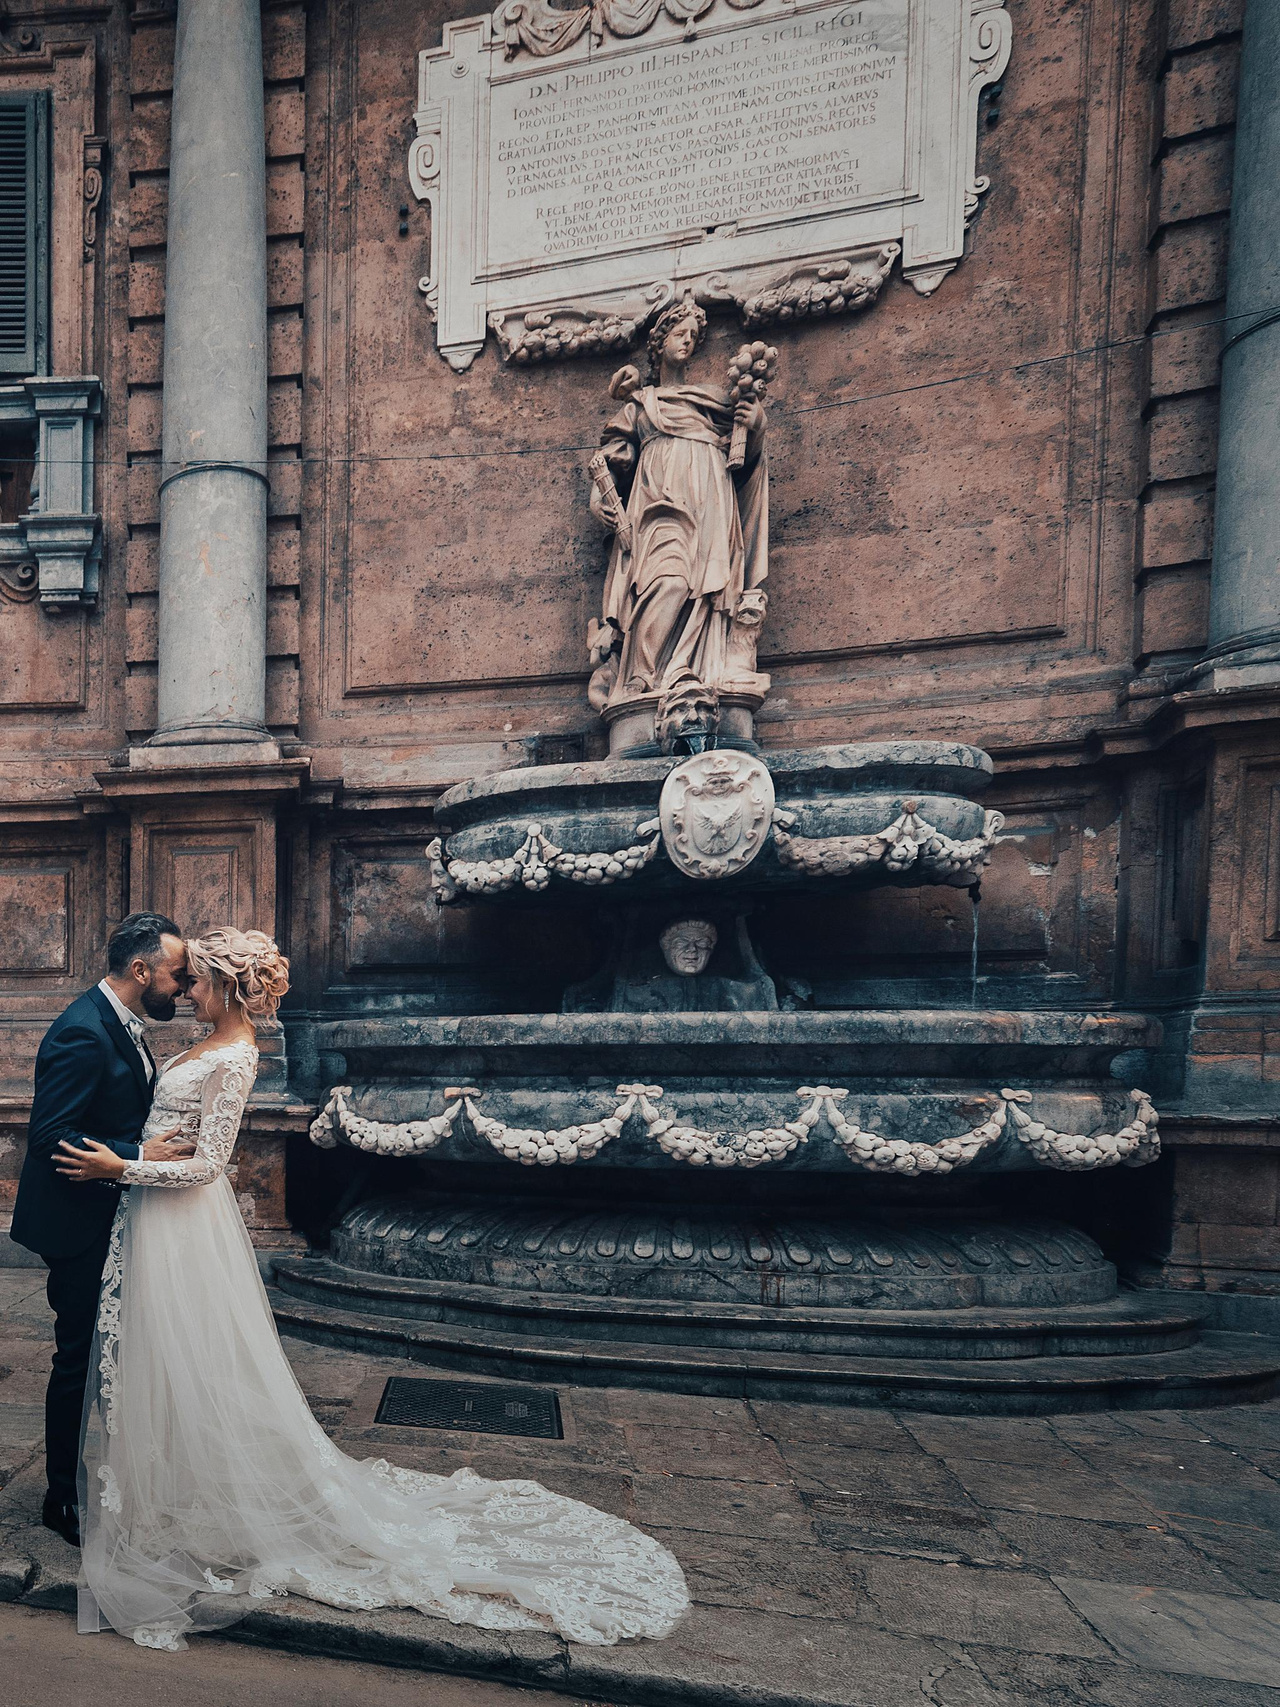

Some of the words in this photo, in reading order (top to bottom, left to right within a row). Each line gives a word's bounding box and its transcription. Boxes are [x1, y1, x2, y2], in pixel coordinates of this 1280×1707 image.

[815, 11, 862, 33] REGI
[824, 88, 878, 108] ALVARVS
[807, 114, 875, 137] SENATORES
[773, 148, 848, 172] PANHORMVS
[825, 159, 858, 174] FACTI
[602, 216, 625, 229] COR
